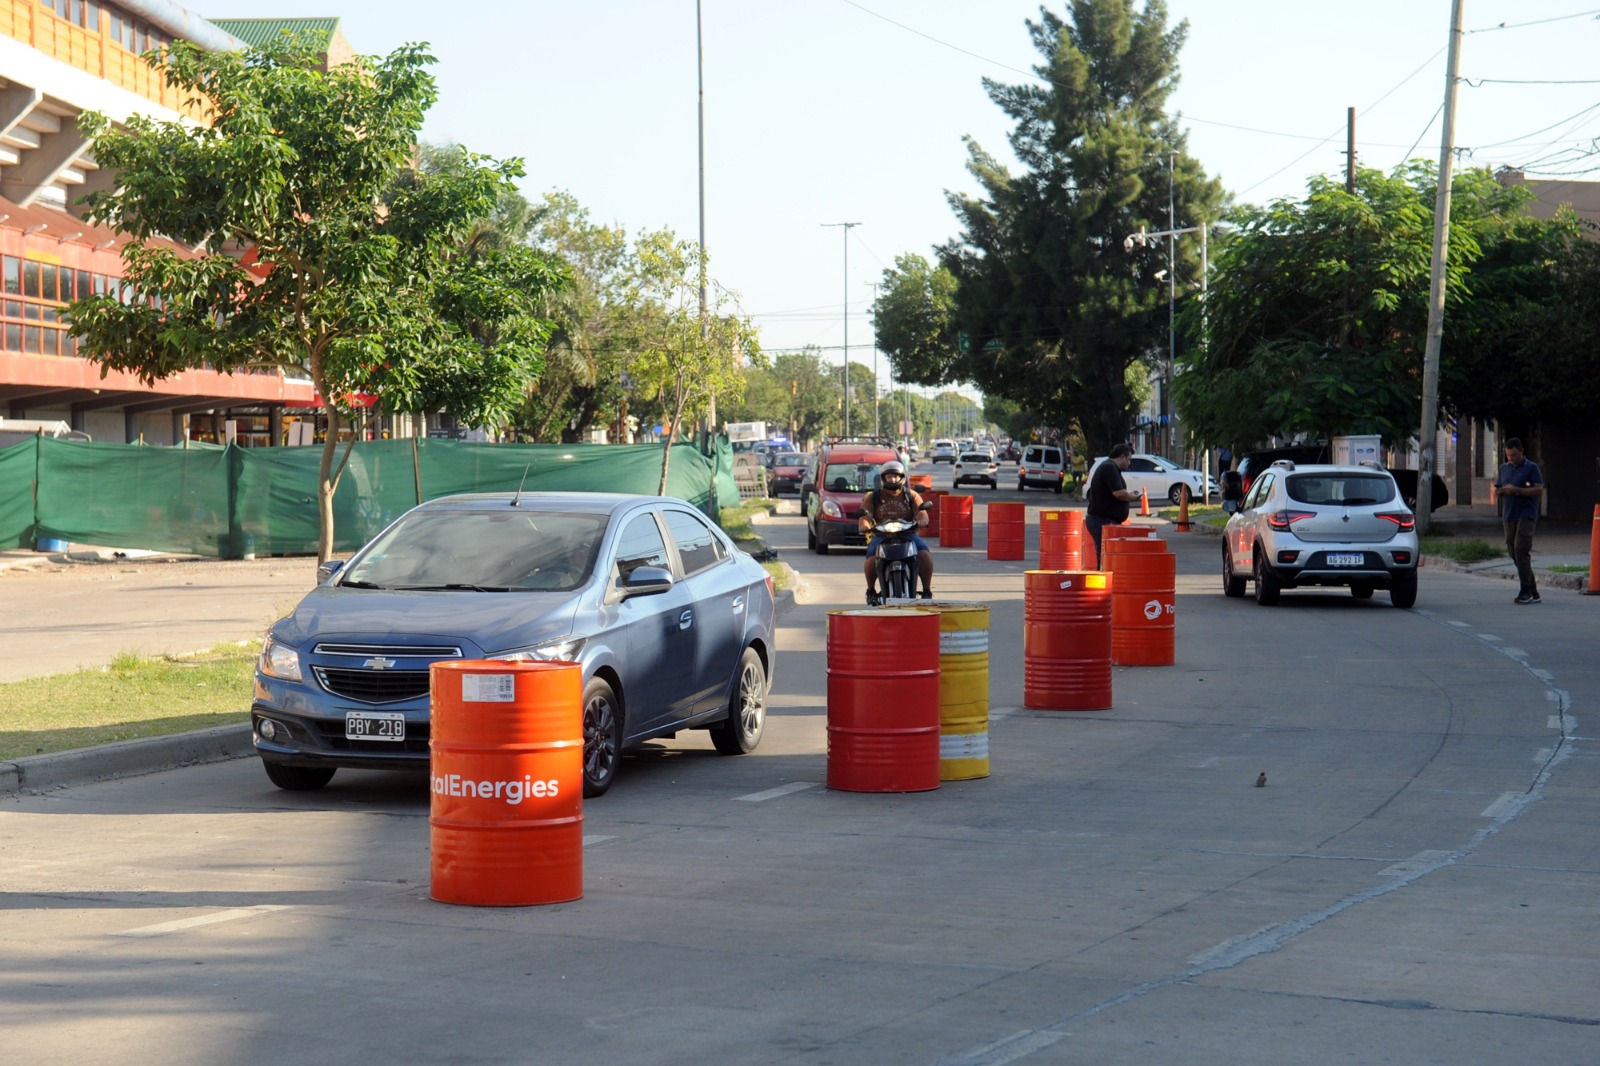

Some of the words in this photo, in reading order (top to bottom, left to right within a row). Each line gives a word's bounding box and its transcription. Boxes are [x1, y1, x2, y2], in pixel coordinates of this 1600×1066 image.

[1339, 556, 1352, 564] 292
[348, 719, 371, 735] PBY
[378, 720, 402, 736] 218
